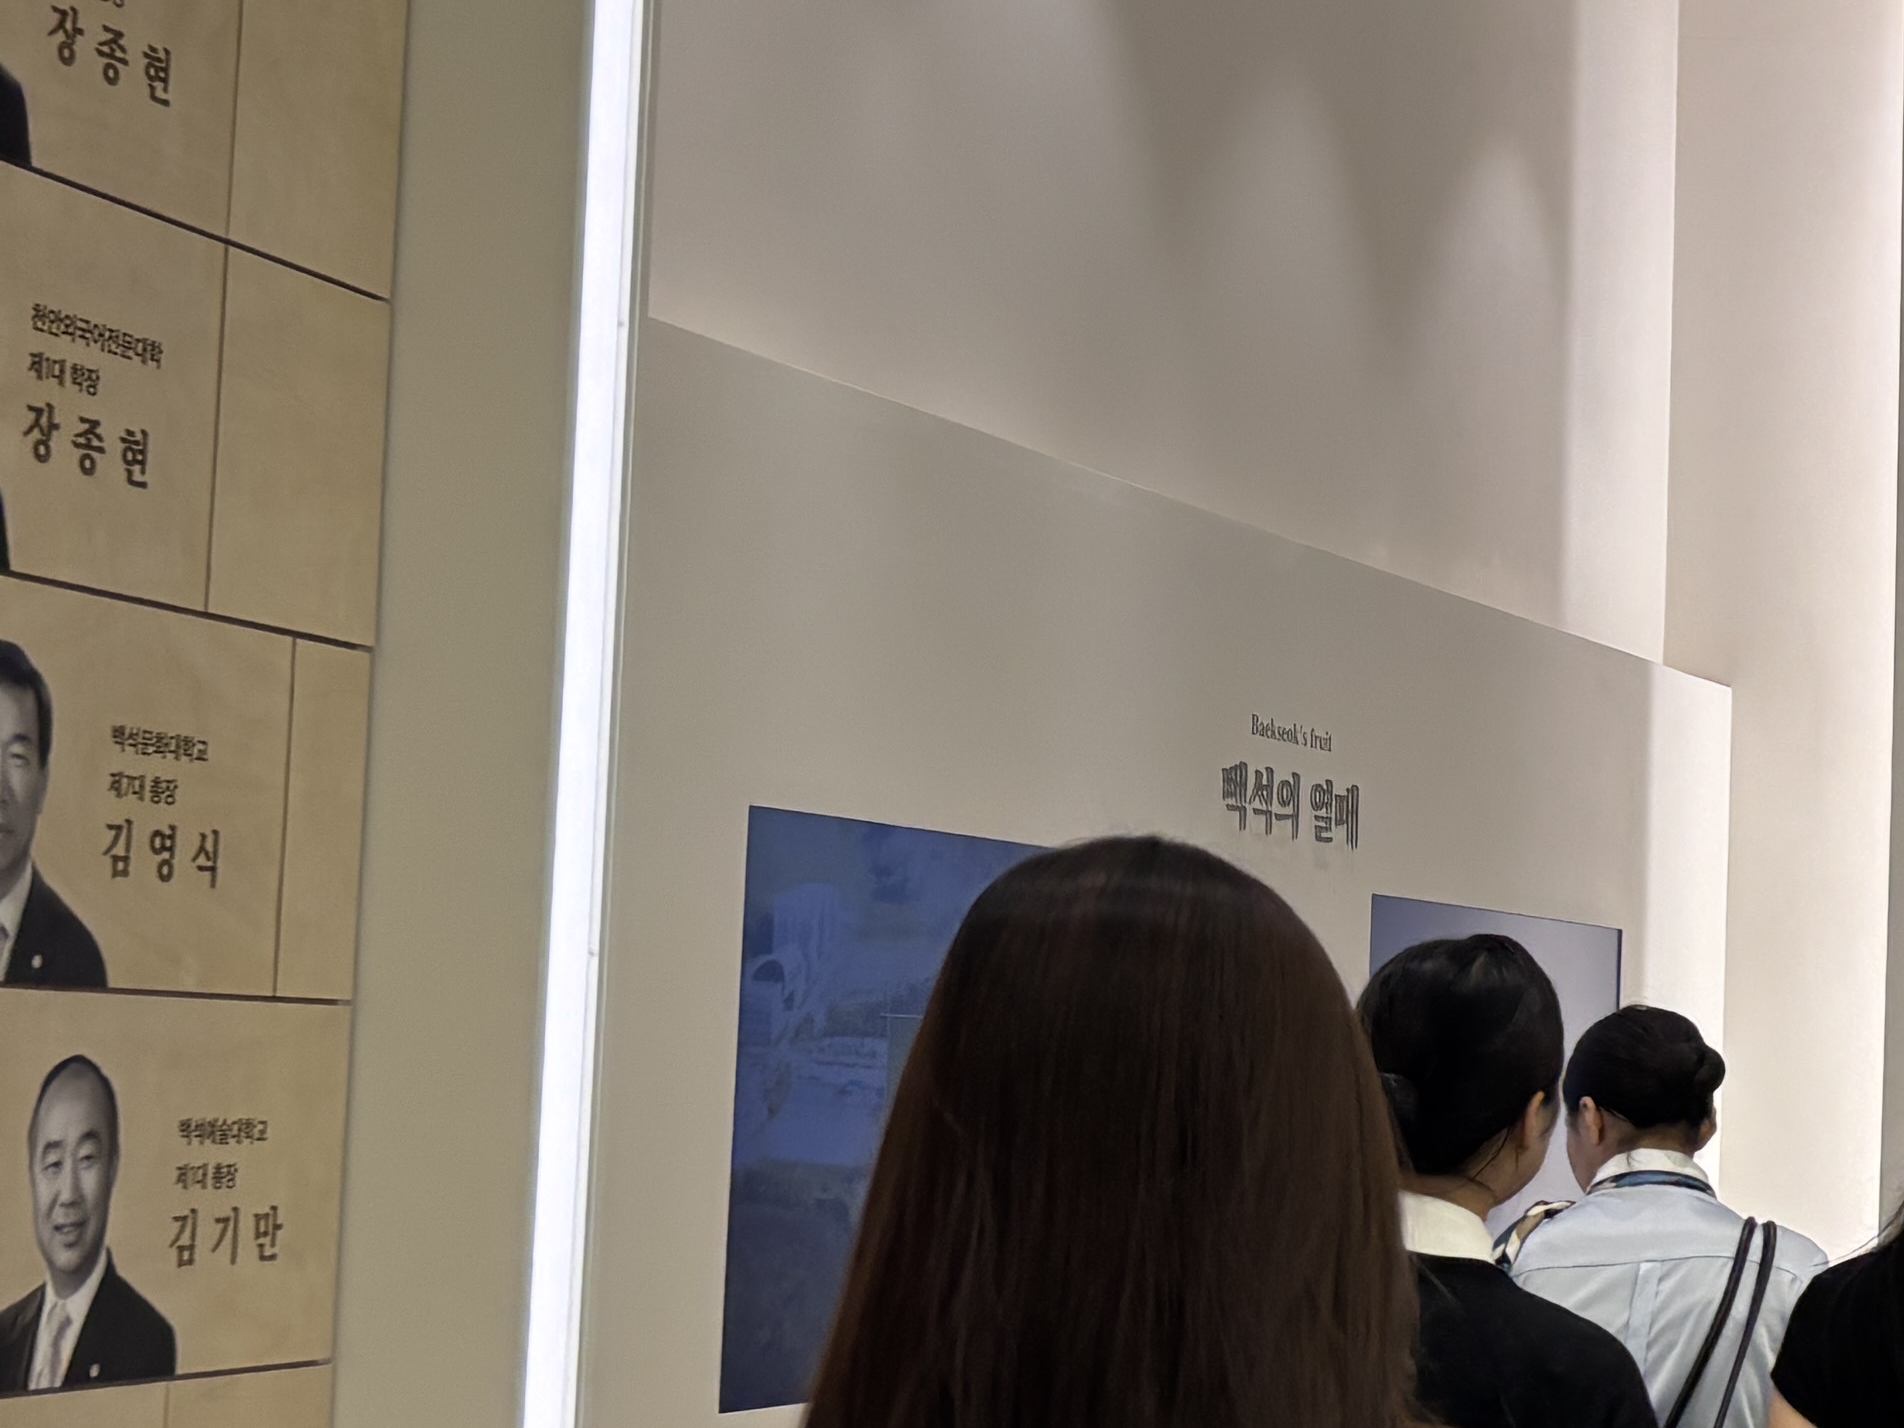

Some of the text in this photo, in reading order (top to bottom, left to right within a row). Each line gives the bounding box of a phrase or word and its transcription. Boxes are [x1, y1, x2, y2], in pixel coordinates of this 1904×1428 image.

[70, 363, 100, 397] 학장
[111, 725, 208, 762] 백석문화대학교
[1251, 713, 1332, 752] Baekseok's fruit
[150, 776, 178, 805] 총장
[1221, 761, 1360, 851] 백석의 열매
[212, 1163, 239, 1190] 총장
